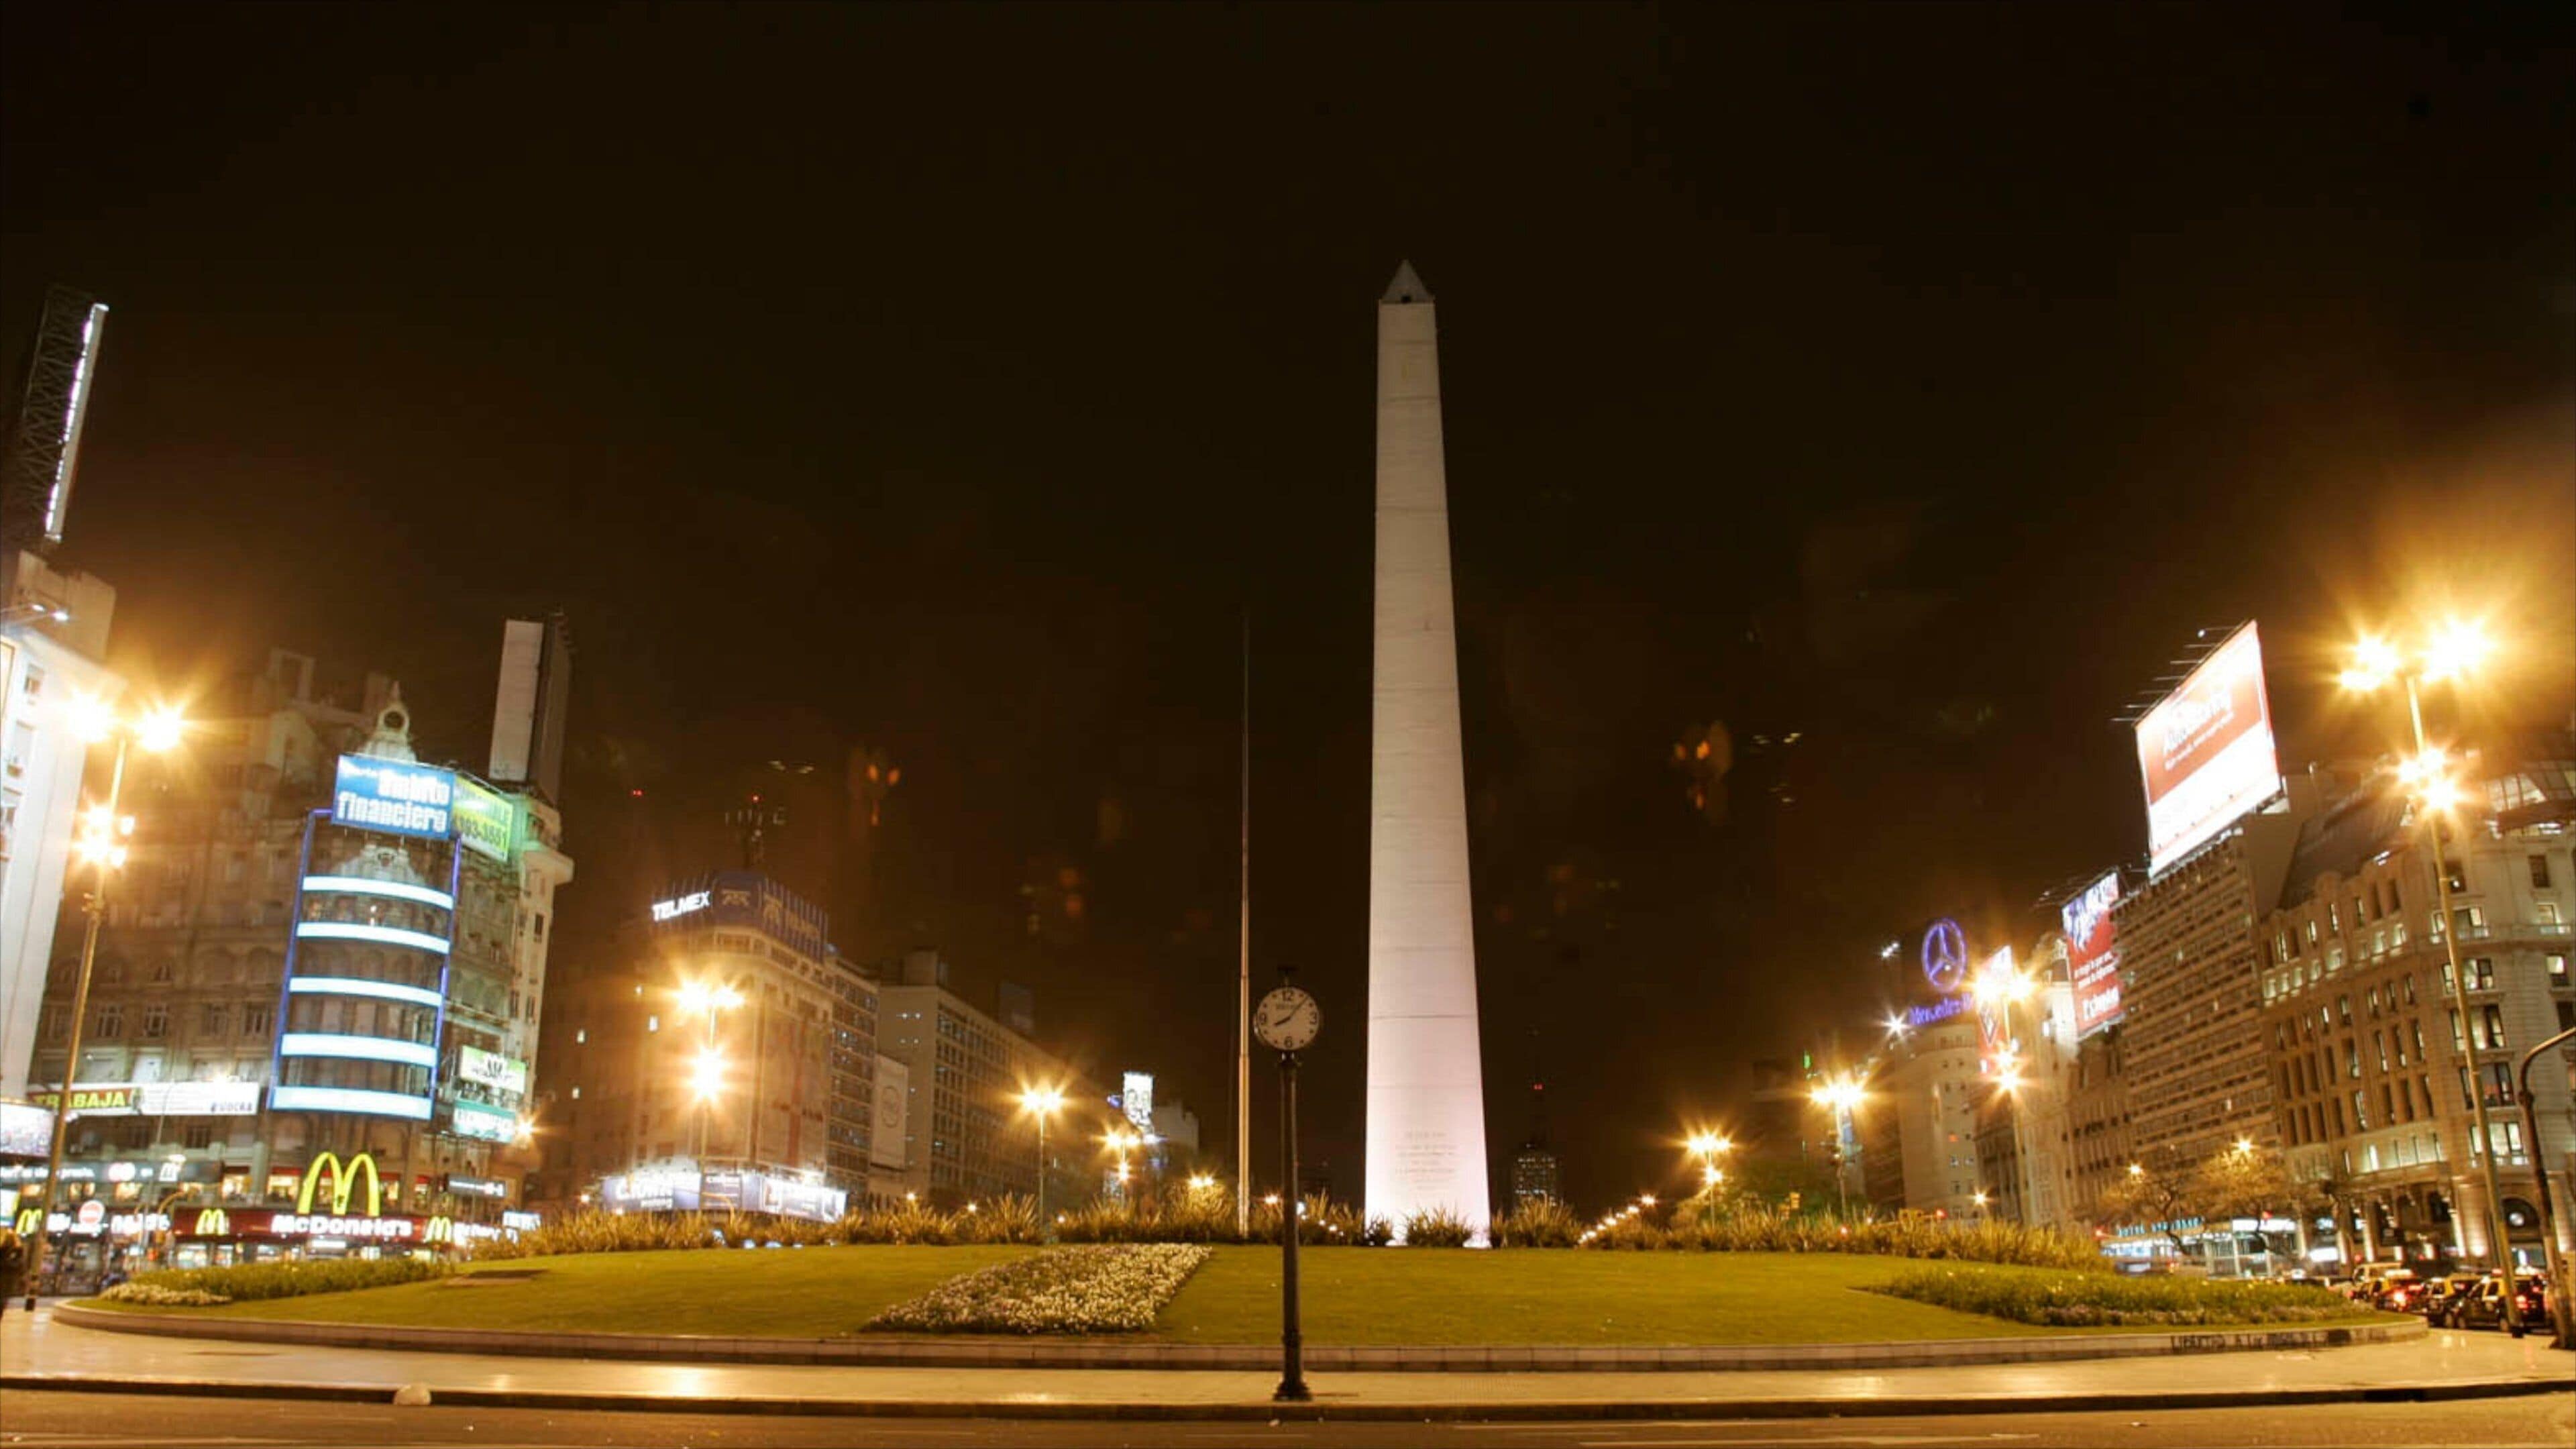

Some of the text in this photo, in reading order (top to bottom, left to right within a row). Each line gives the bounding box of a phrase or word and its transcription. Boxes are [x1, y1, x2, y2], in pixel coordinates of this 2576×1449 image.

[652, 891, 710, 922] TELMEX
[1282, 990, 1293, 1002] 12
[1309, 1011, 1318, 1025] 3
[1283, 1035, 1293, 1048] 6
[35, 1091, 126, 1110] TRBAJA
[271, 1214, 413, 1238] McDonald's
